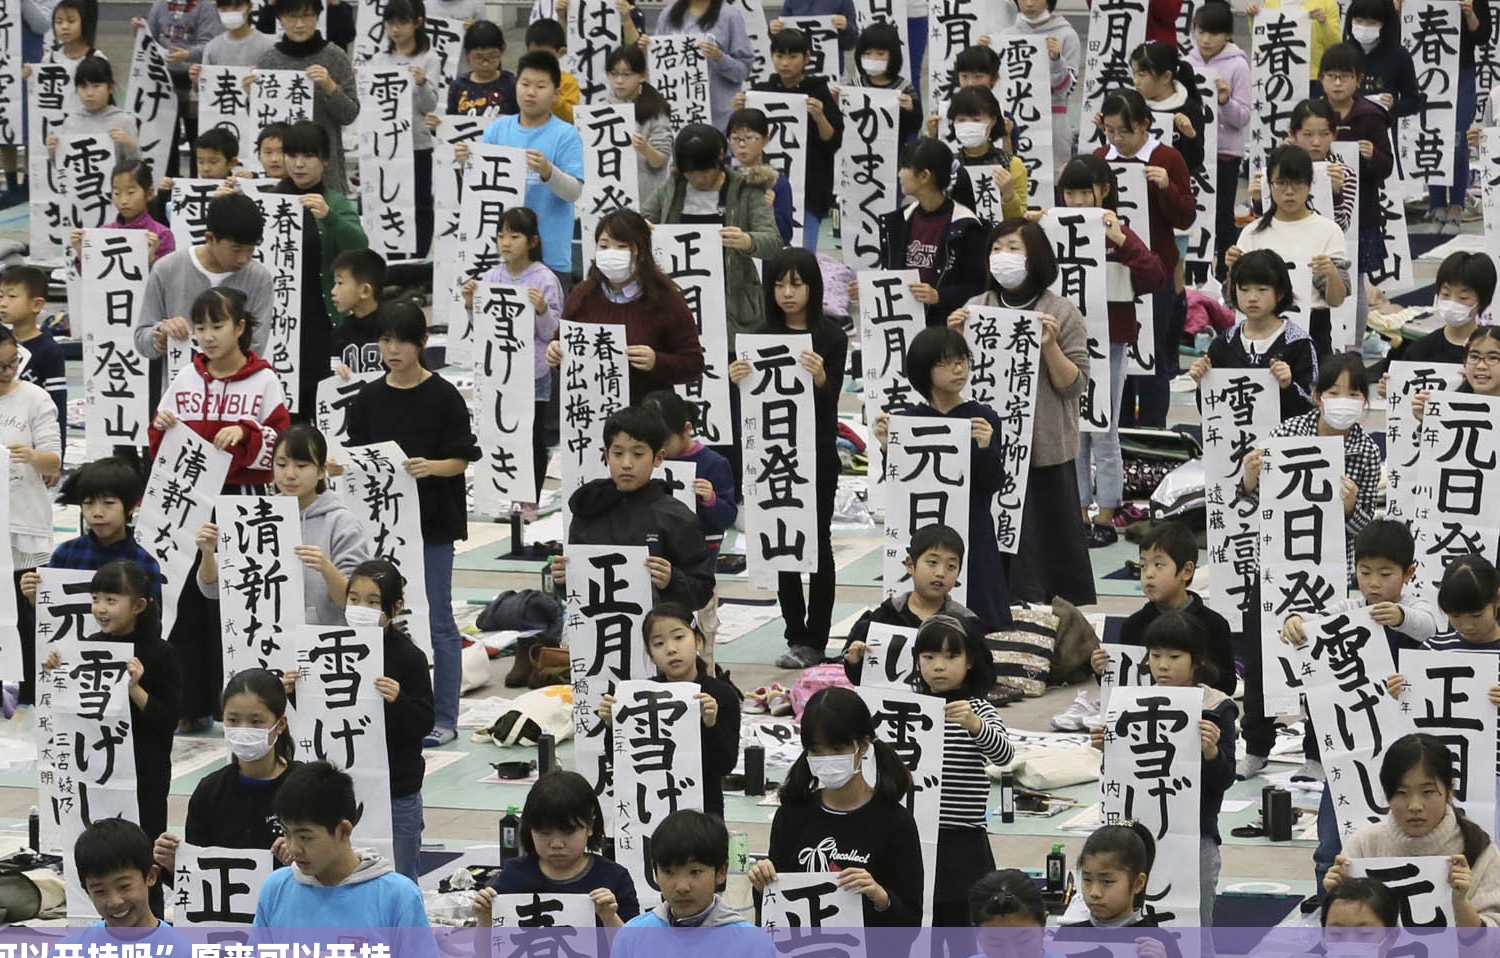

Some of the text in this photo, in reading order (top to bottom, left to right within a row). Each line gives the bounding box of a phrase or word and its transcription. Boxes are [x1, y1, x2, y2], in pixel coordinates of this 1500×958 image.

[1412, 6, 1459, 186] 春の七草
[370, 71, 410, 250] 雪げしき
[850, 98, 893, 268] かまくら
[94, 237, 146, 450] 元日登山
[484, 288, 525, 494] 雪げしき
[564, 327, 595, 466] 語出梅中
[996, 316, 1041, 549] 春情寄柳色鳥
[1205, 392, 1223, 444] 中一年
[1388, 393, 1402, 443] 中一年
[1423, 402, 1440, 444] 五年
[752, 345, 809, 562] 元日登山
[887, 430, 901, 481] 五年
[38, 592, 54, 636] 五年
[566, 588, 583, 630] 六年
[176, 864, 193, 910] 六年
[828, 836, 872, 864] Recollect
